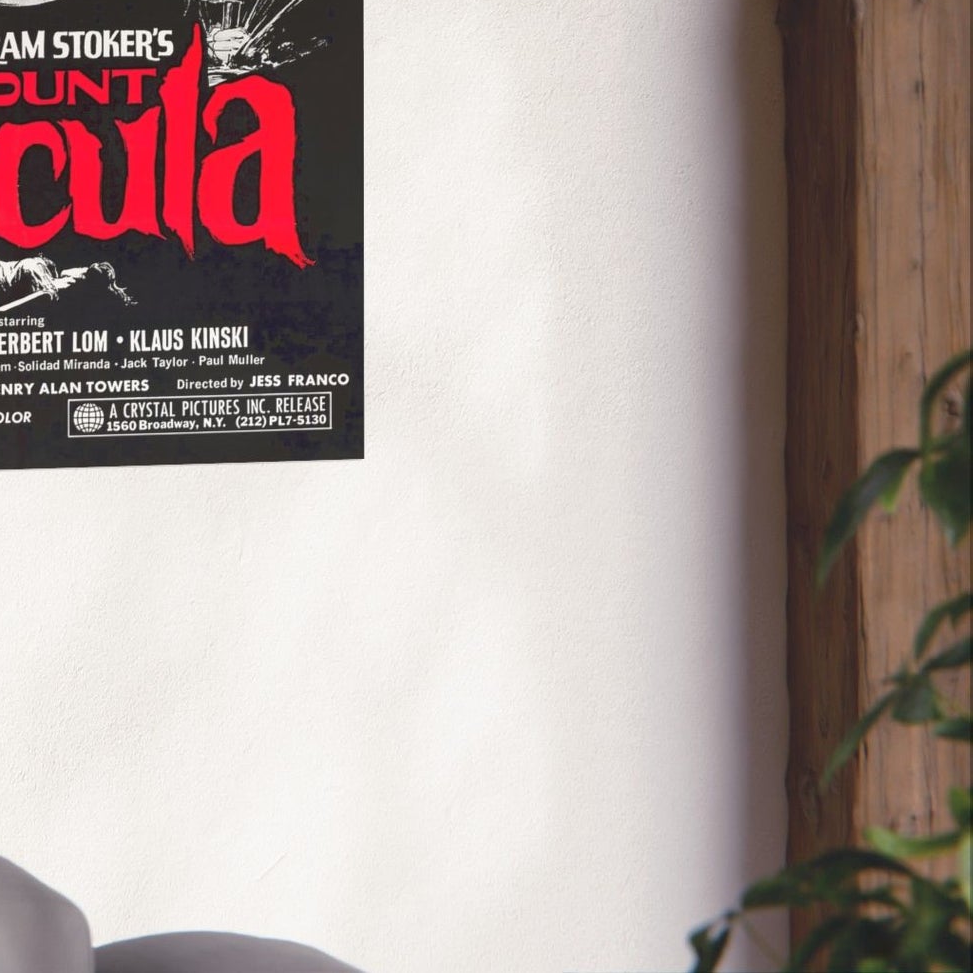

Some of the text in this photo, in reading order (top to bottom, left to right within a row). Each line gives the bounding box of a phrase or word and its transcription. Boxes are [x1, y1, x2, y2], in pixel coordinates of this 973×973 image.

[52, 29, 174, 61] STOKER'S
[72, 330, 108, 353] LOM
[130, 328, 184, 352] KLAUS
[191, 326, 249, 349] KINSKI
[18, 359, 60, 371] Solidad
[63, 358, 110, 370] Miranda
[121, 357, 147, 368] Jack
[153, 356, 187, 369] Taylor
[199, 355, 223, 366] Paul
[228, 354, 265, 365] Muller
[39, 380, 82, 395] ALAN
[86, 379, 149, 393] TOWERS
[177, 378, 227, 390] Directed
[230, 377, 244, 390] by
[249, 375, 281, 388] JESS
[288, 373, 349, 387] FRANCO
[109, 396, 327, 419] A CRYSTAL PICTURES INC. RELEASE
[106, 413, 327, 432] 1560 Broadway, N.Y. (212) PL7-5130
